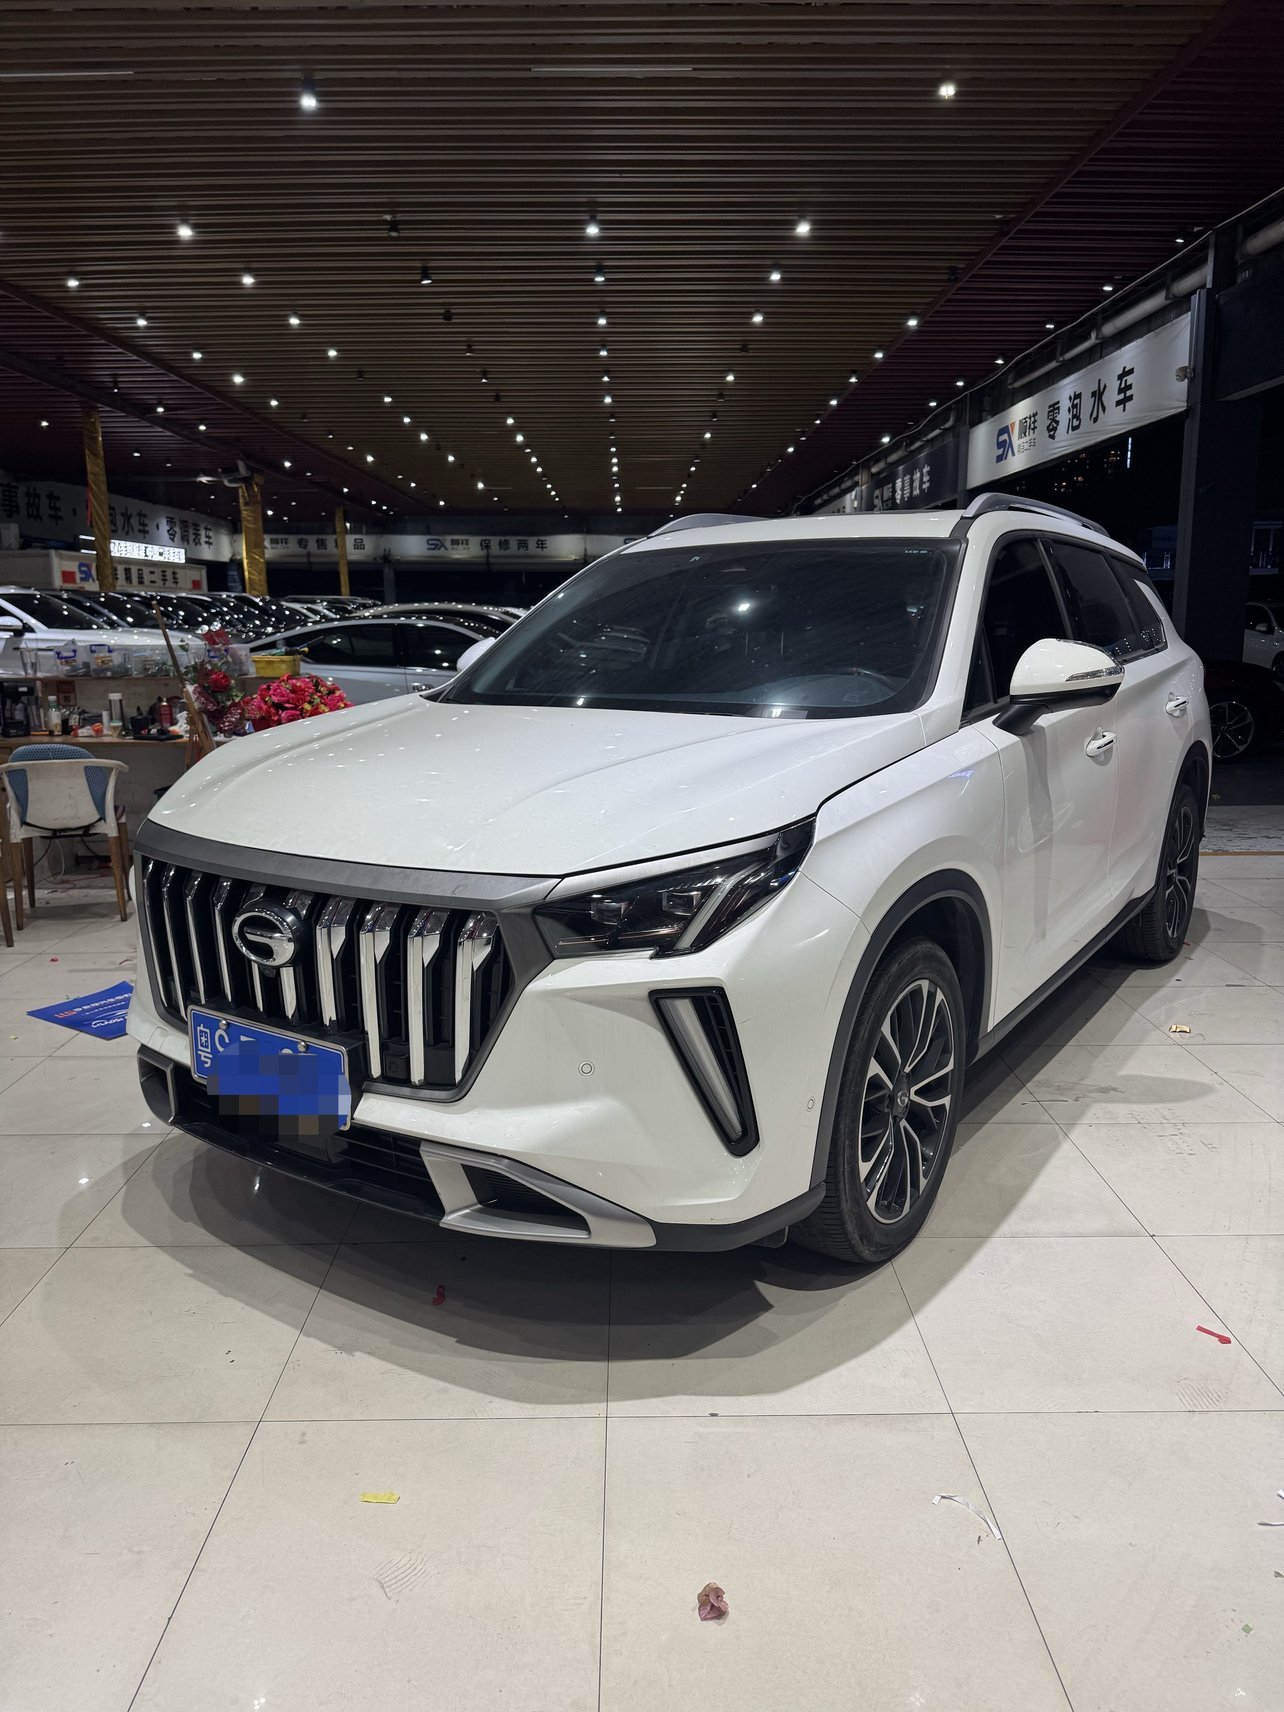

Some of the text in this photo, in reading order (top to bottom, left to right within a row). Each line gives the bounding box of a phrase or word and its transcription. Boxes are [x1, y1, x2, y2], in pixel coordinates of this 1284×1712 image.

[1046, 365, 1135, 441] 零泡水车
[894, 464, 931, 505] 零事故车
[479, 538, 549, 552] 保修两年
